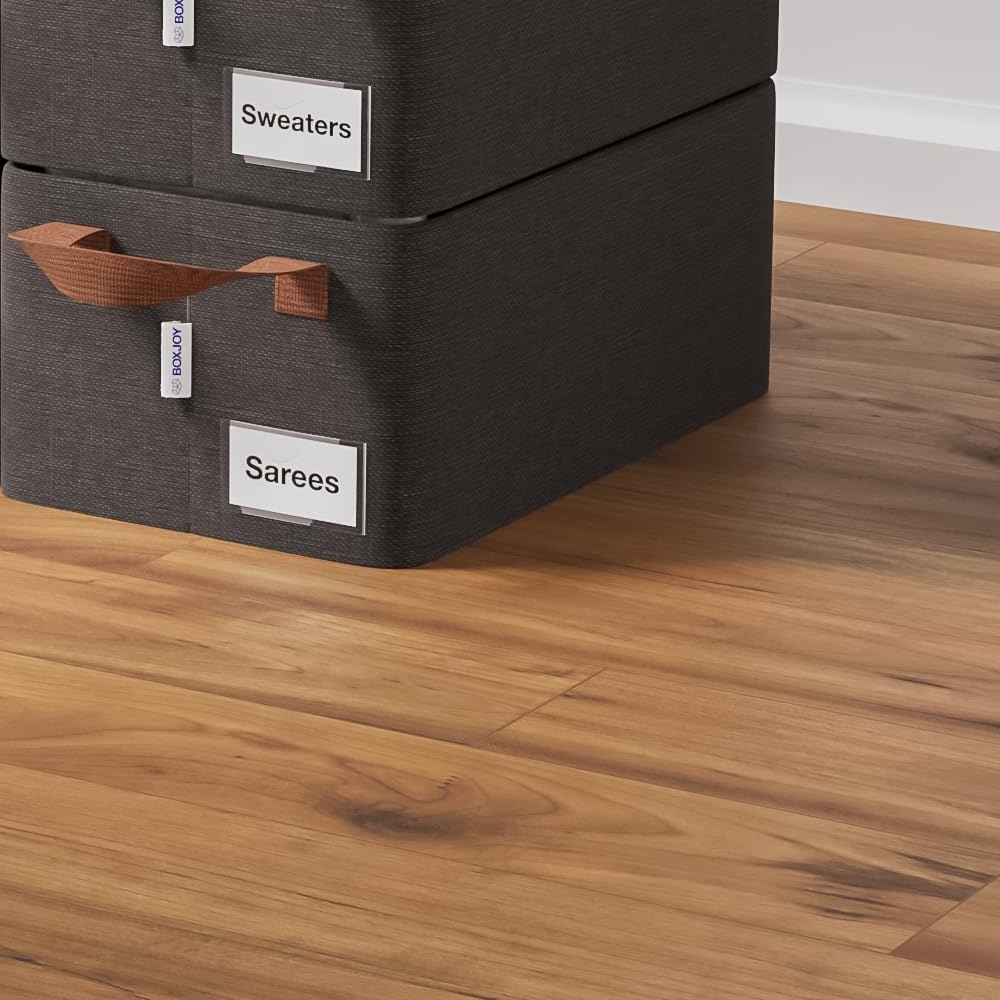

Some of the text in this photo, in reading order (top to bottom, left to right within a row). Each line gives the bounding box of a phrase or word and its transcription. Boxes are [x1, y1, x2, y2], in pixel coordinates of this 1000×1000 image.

[241, 103, 352, 139] Sweaters
[172, 327, 182, 376] BOXJOY
[245, 455, 340, 494] Sarees
